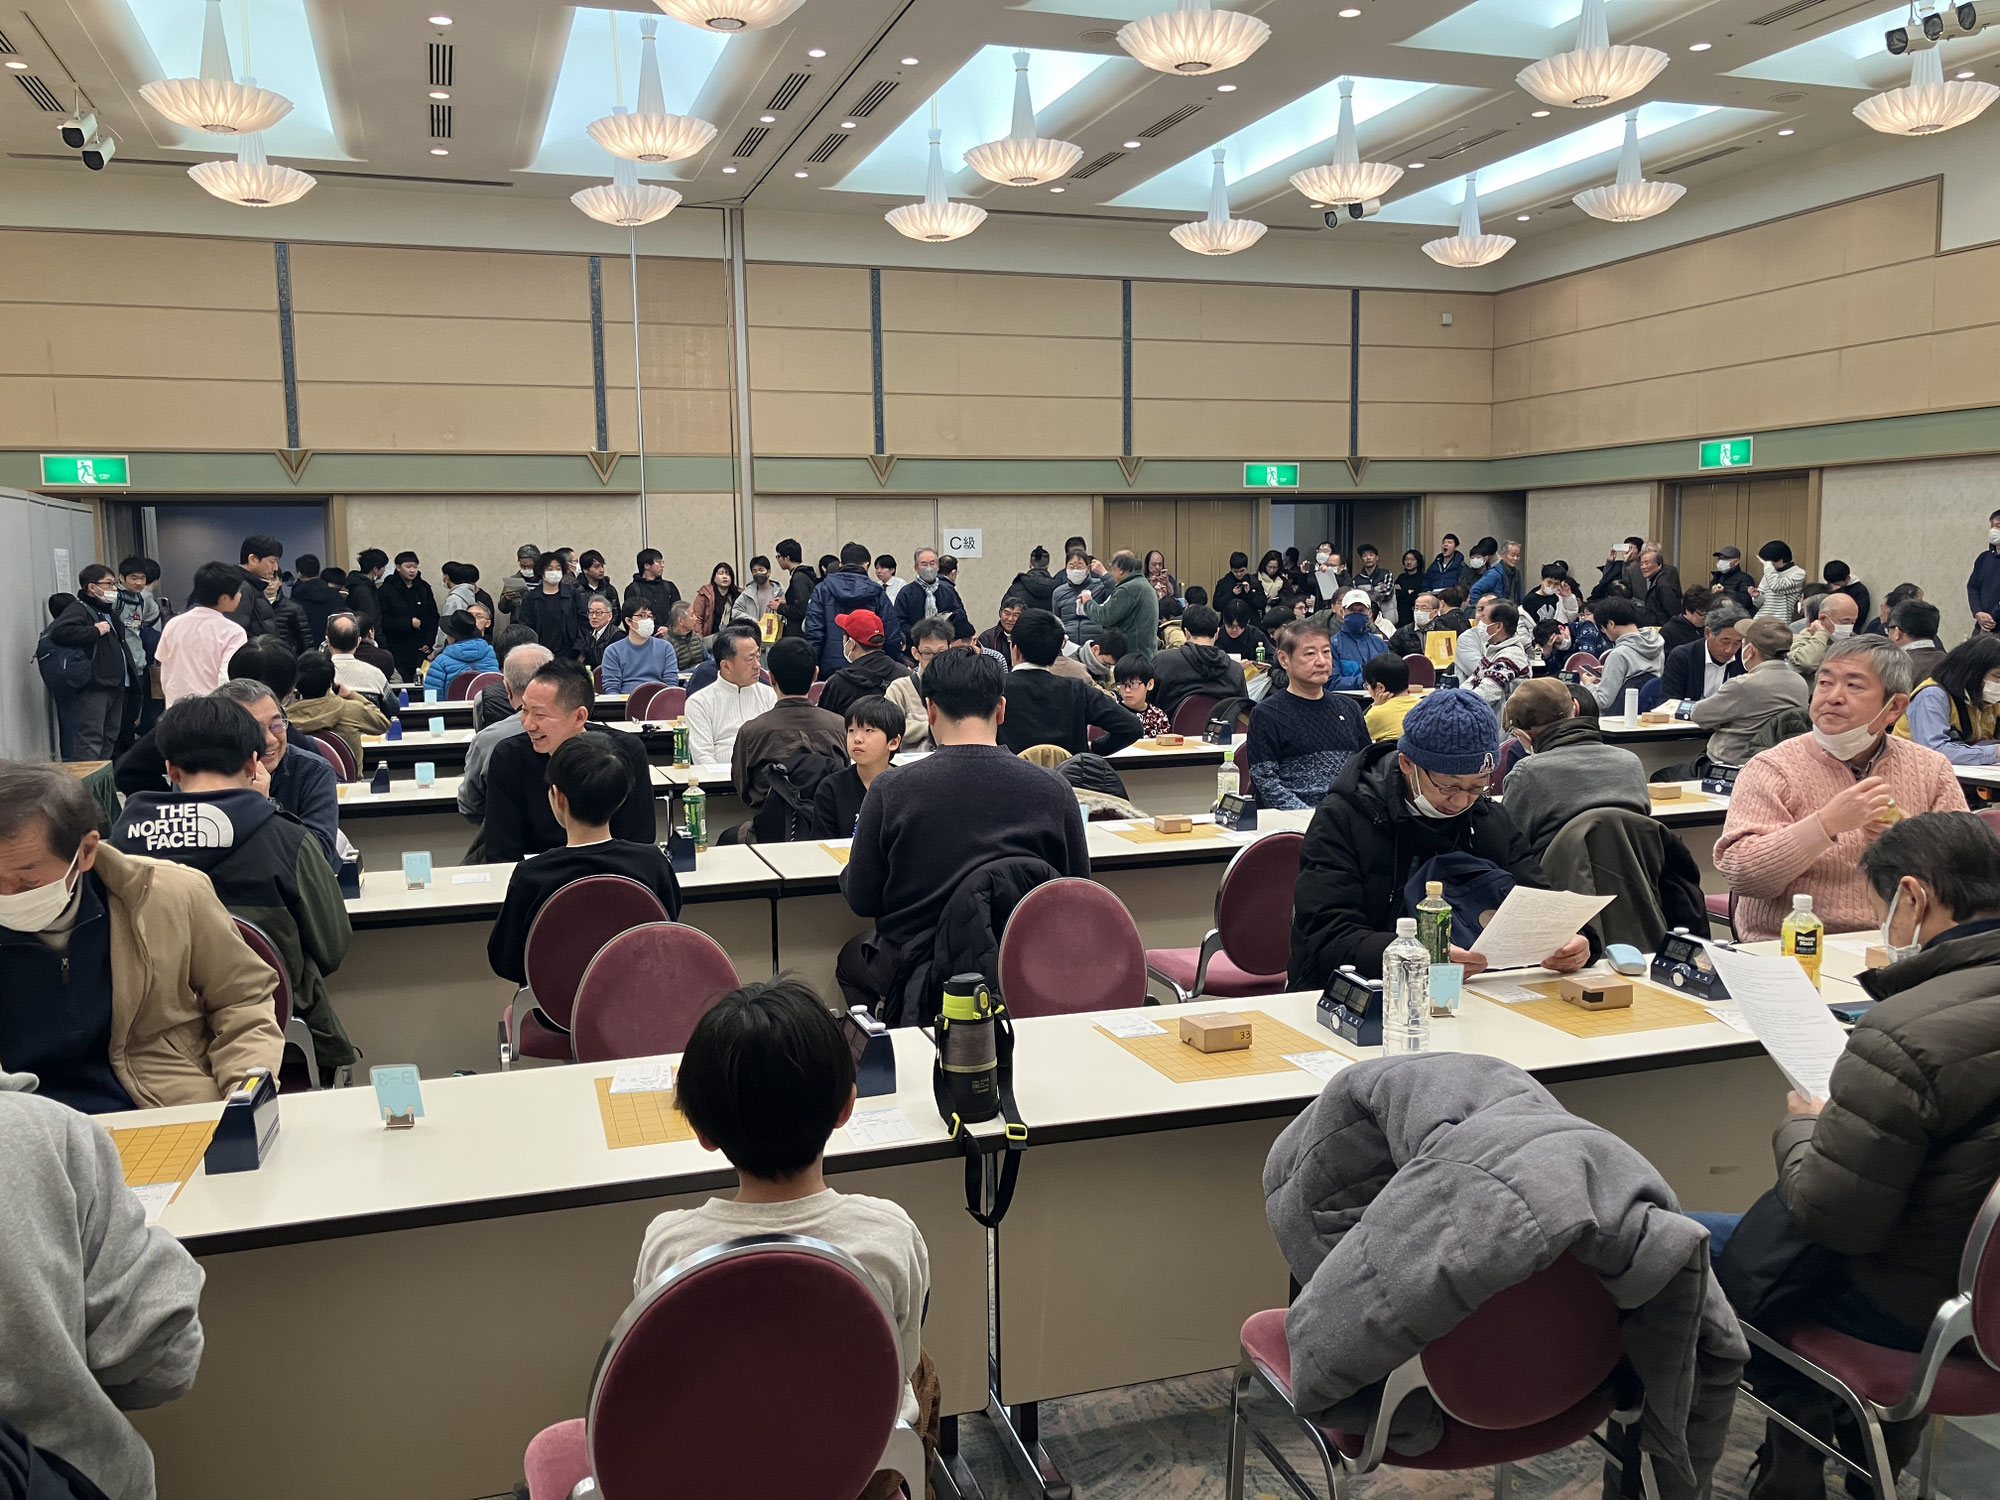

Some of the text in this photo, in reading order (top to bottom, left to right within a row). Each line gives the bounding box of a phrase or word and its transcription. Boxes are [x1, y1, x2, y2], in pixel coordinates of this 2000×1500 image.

[949, 536, 976, 550] C級
[155, 802, 197, 819] THE
[127, 817, 197, 839] NORTH
[146, 831, 197, 851] FACE
[1239, 1030, 1251, 1040] 33
